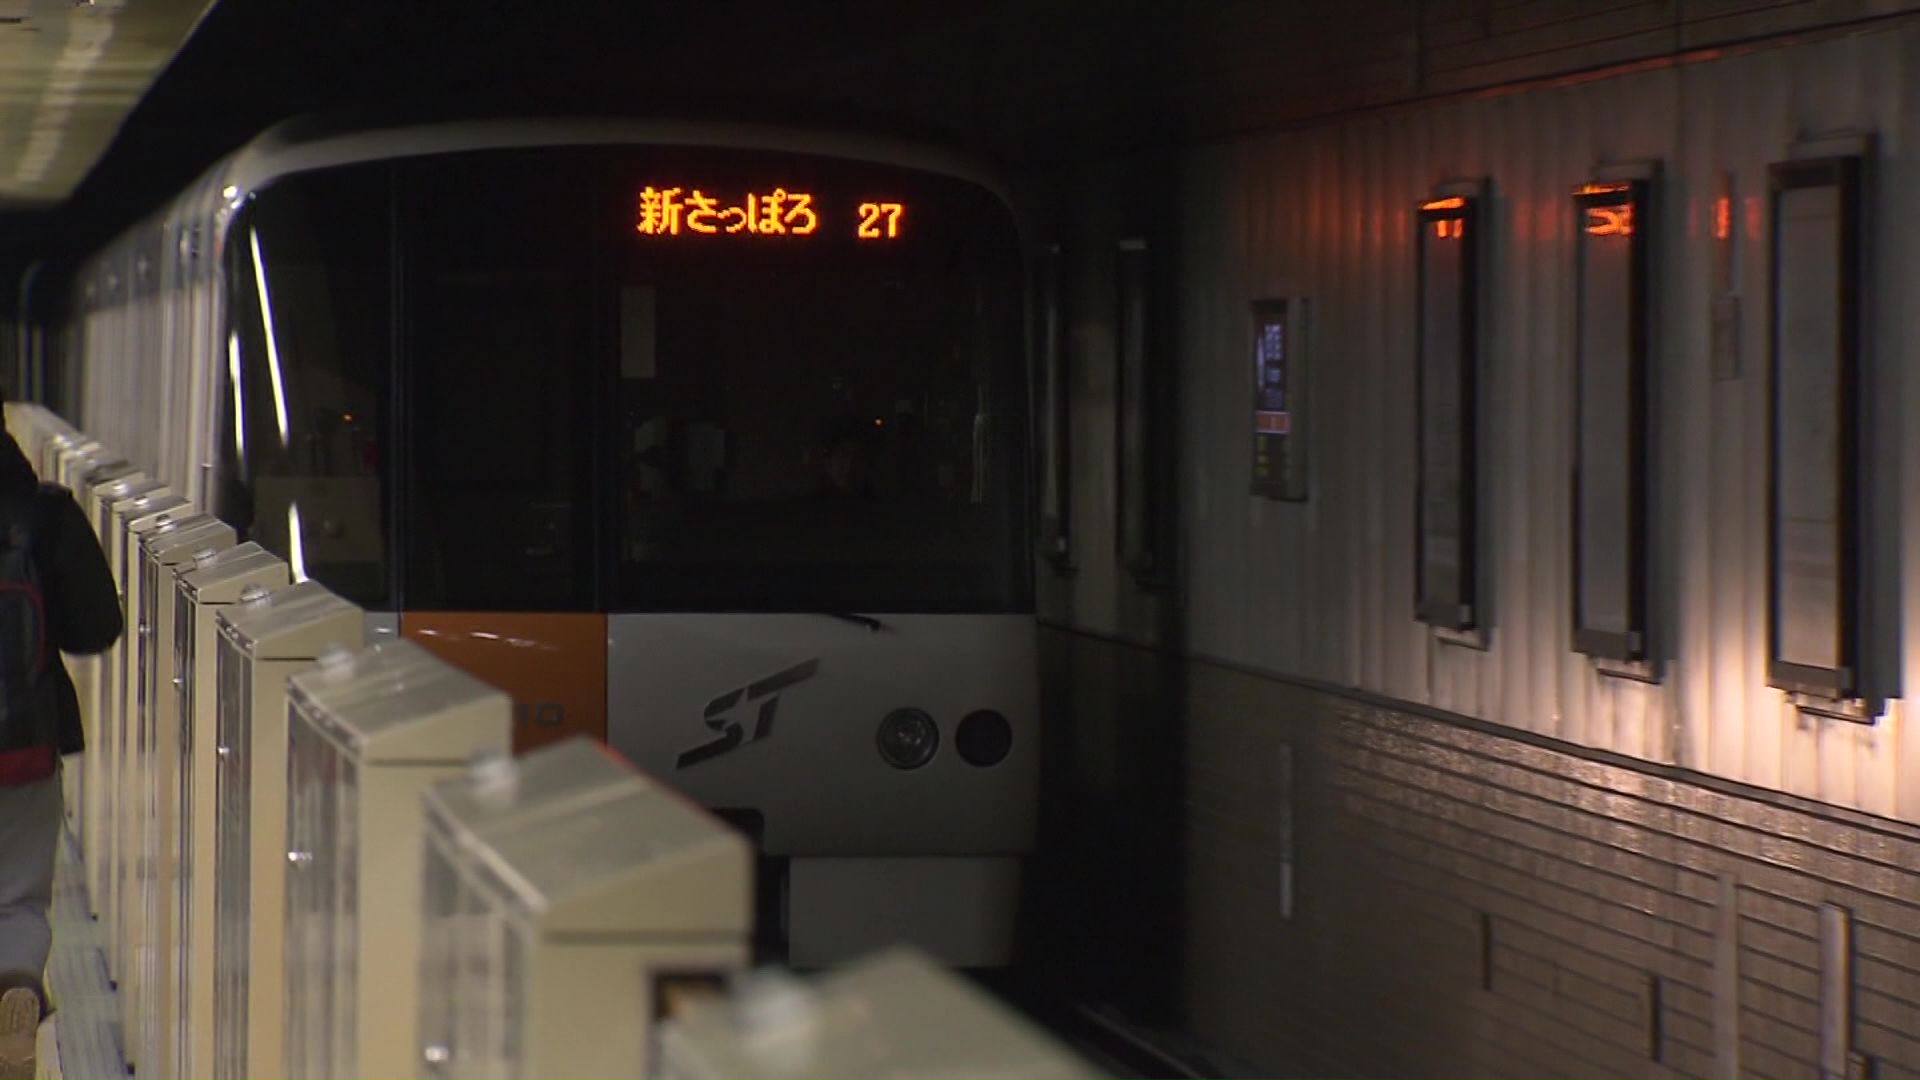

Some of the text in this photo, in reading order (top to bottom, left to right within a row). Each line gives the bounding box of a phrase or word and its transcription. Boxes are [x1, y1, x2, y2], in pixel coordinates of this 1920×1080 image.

[637, 186, 904, 239] 新さっぽろ 27
[677, 658, 820, 769] ST
